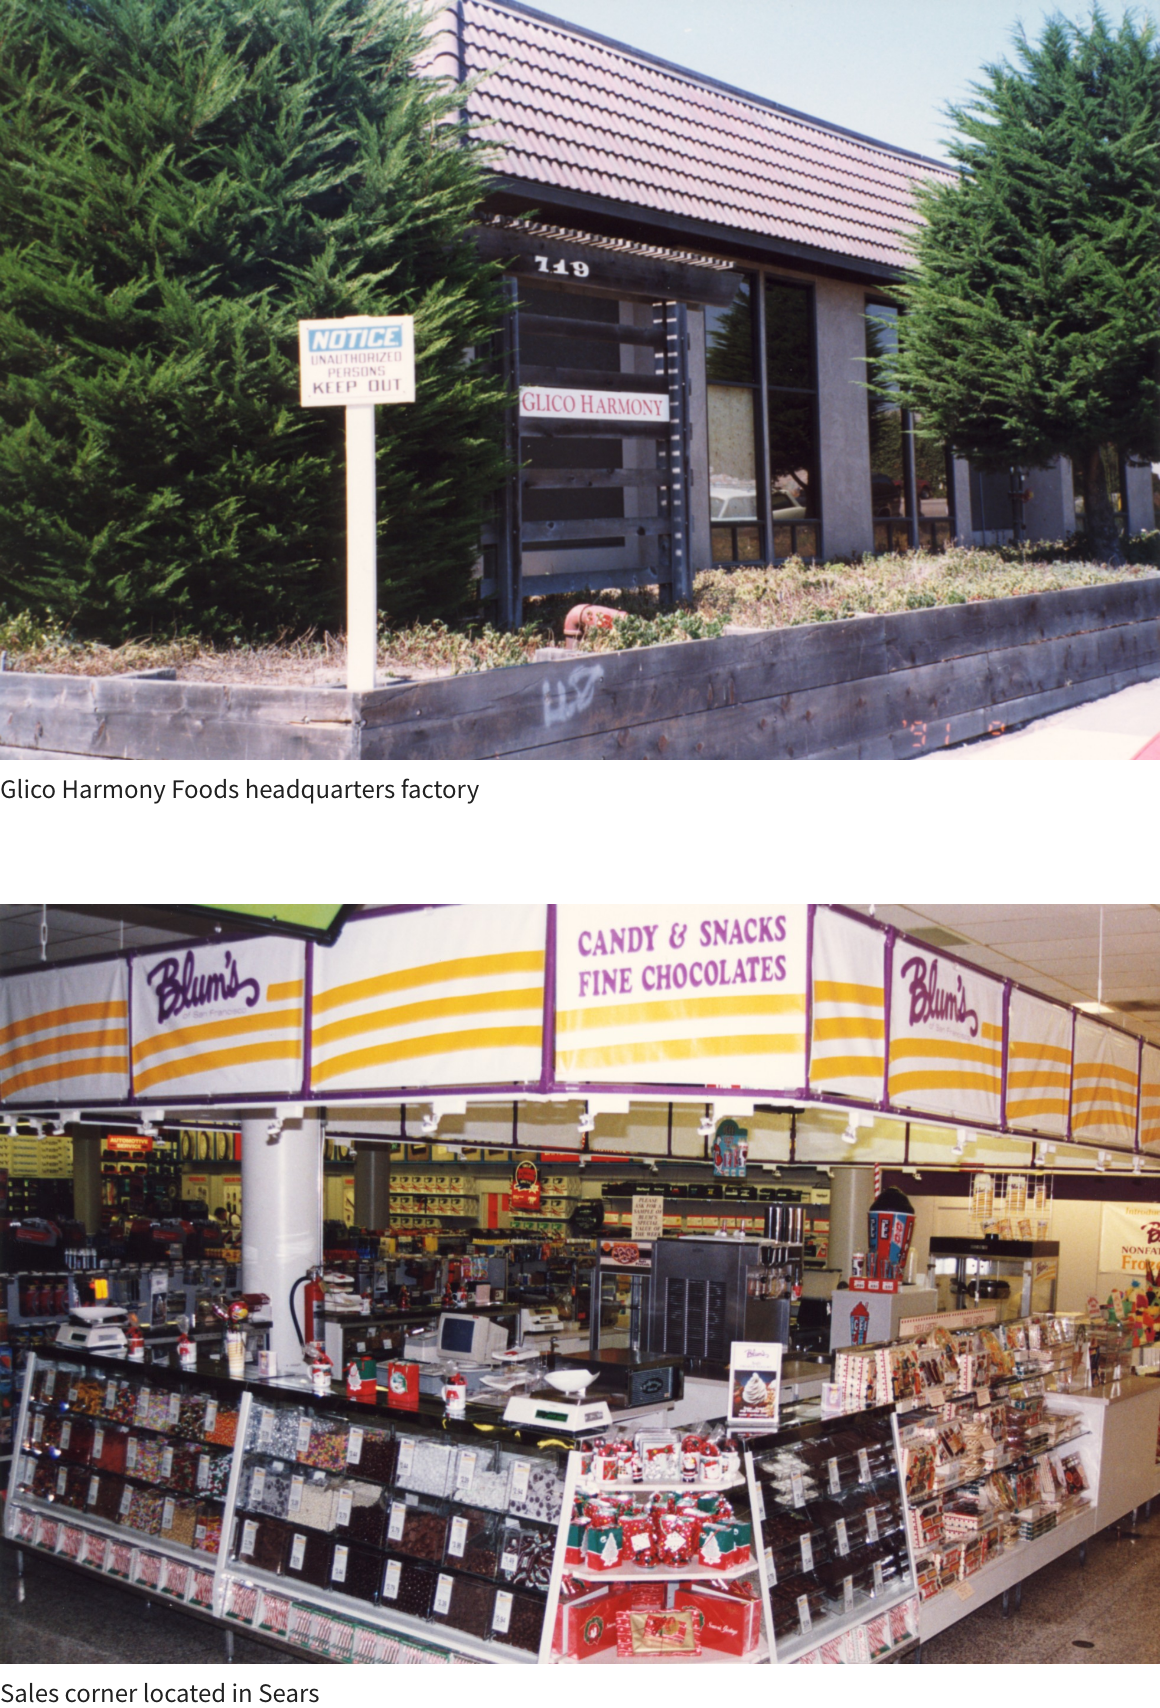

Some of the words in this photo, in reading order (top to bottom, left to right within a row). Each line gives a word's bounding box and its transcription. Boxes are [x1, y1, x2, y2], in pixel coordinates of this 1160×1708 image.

[534, 255, 590, 278] 719
[312, 327, 400, 350] NOTICE
[311, 351, 402, 366] UNAUTHORIZED
[328, 366, 386, 378] PERSONS
[313, 380, 357, 394] KEEP
[368, 378, 402, 392] OUT
[522, 391, 576, 413] GLICO
[580, 394, 663, 416] HARMONY
[578, 924, 659, 957] CANDY
[669, 922, 688, 949] &
[699, 915, 787, 947] SNACKS
[147, 949, 261, 1025] Blum's
[578, 967, 633, 997] FINE
[641, 954, 787, 991] CHOCOLATES
[900, 956, 979, 1038] Blum's
